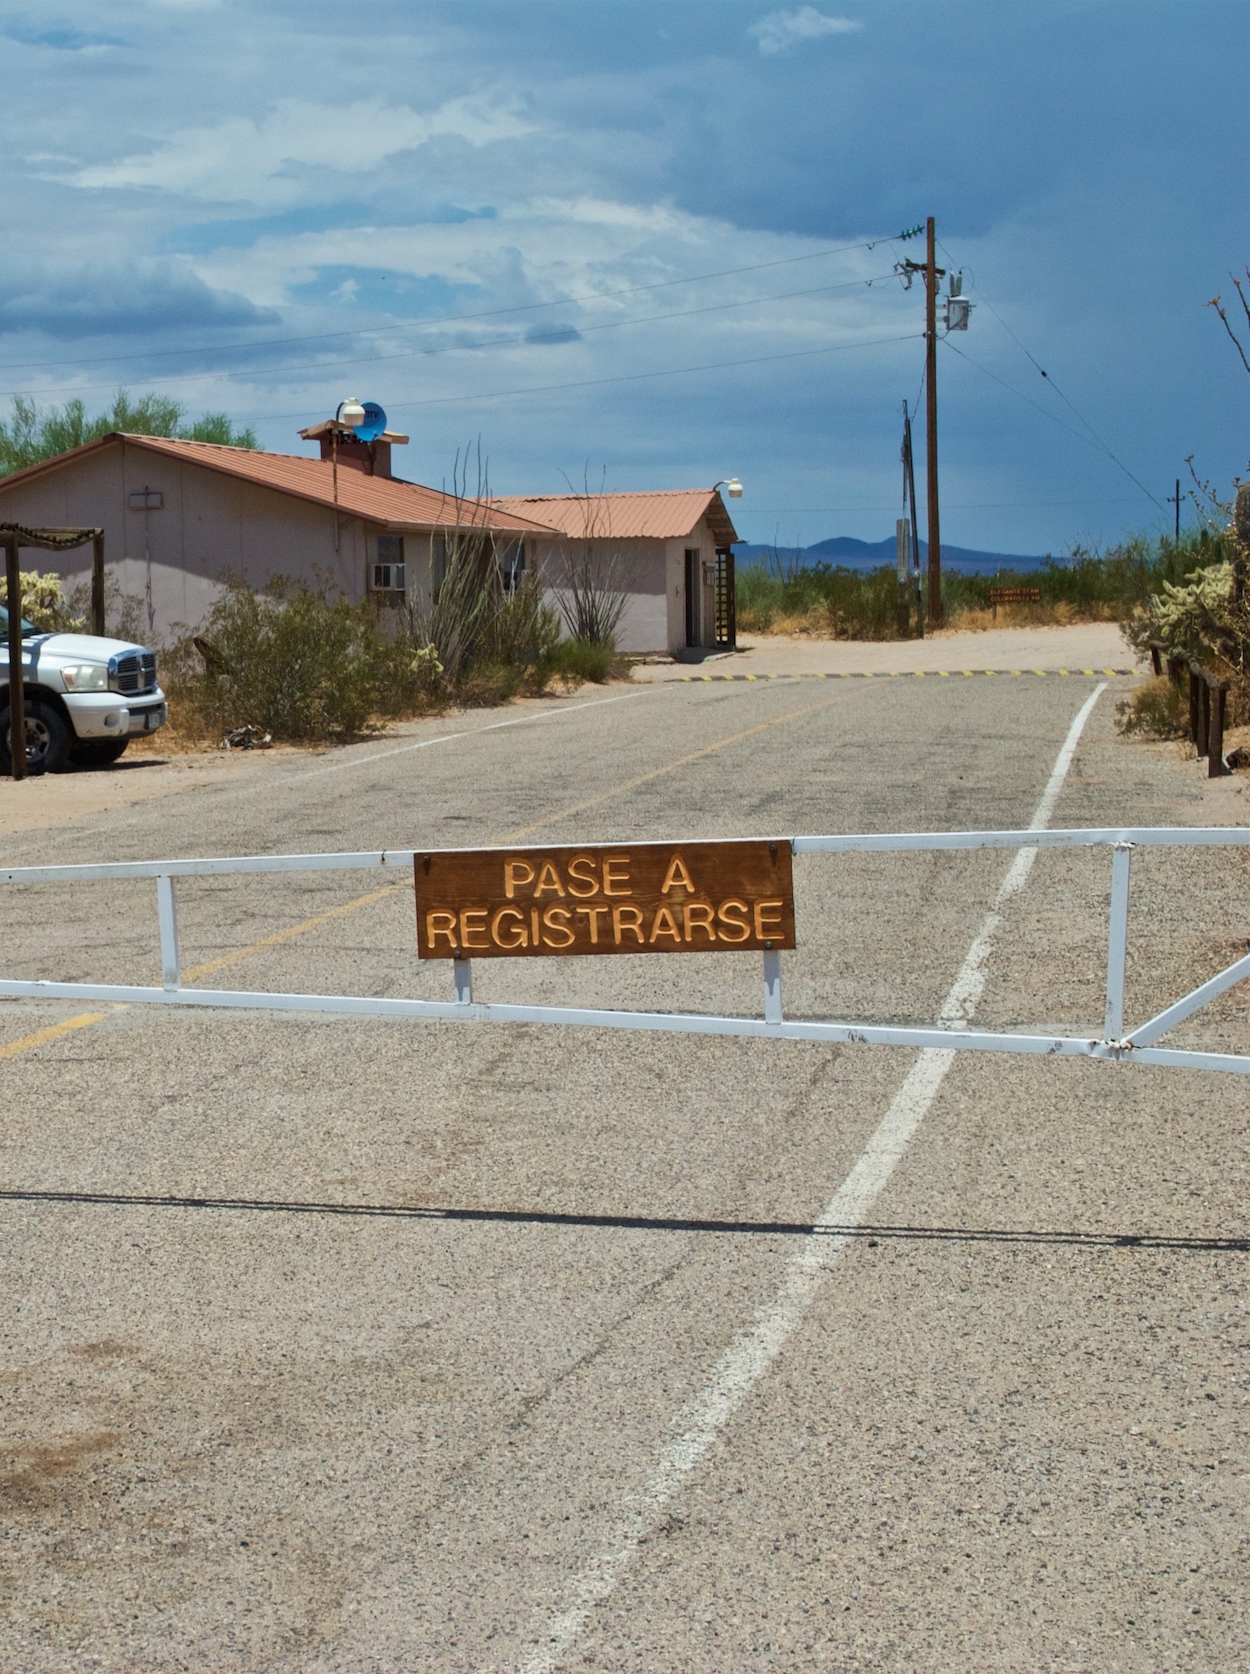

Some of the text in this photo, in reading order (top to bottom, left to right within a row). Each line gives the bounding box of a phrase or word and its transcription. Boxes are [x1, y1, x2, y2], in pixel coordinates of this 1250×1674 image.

[504, 852, 695, 898] PASE A
[426, 901, 785, 949] REGISTRARSE
